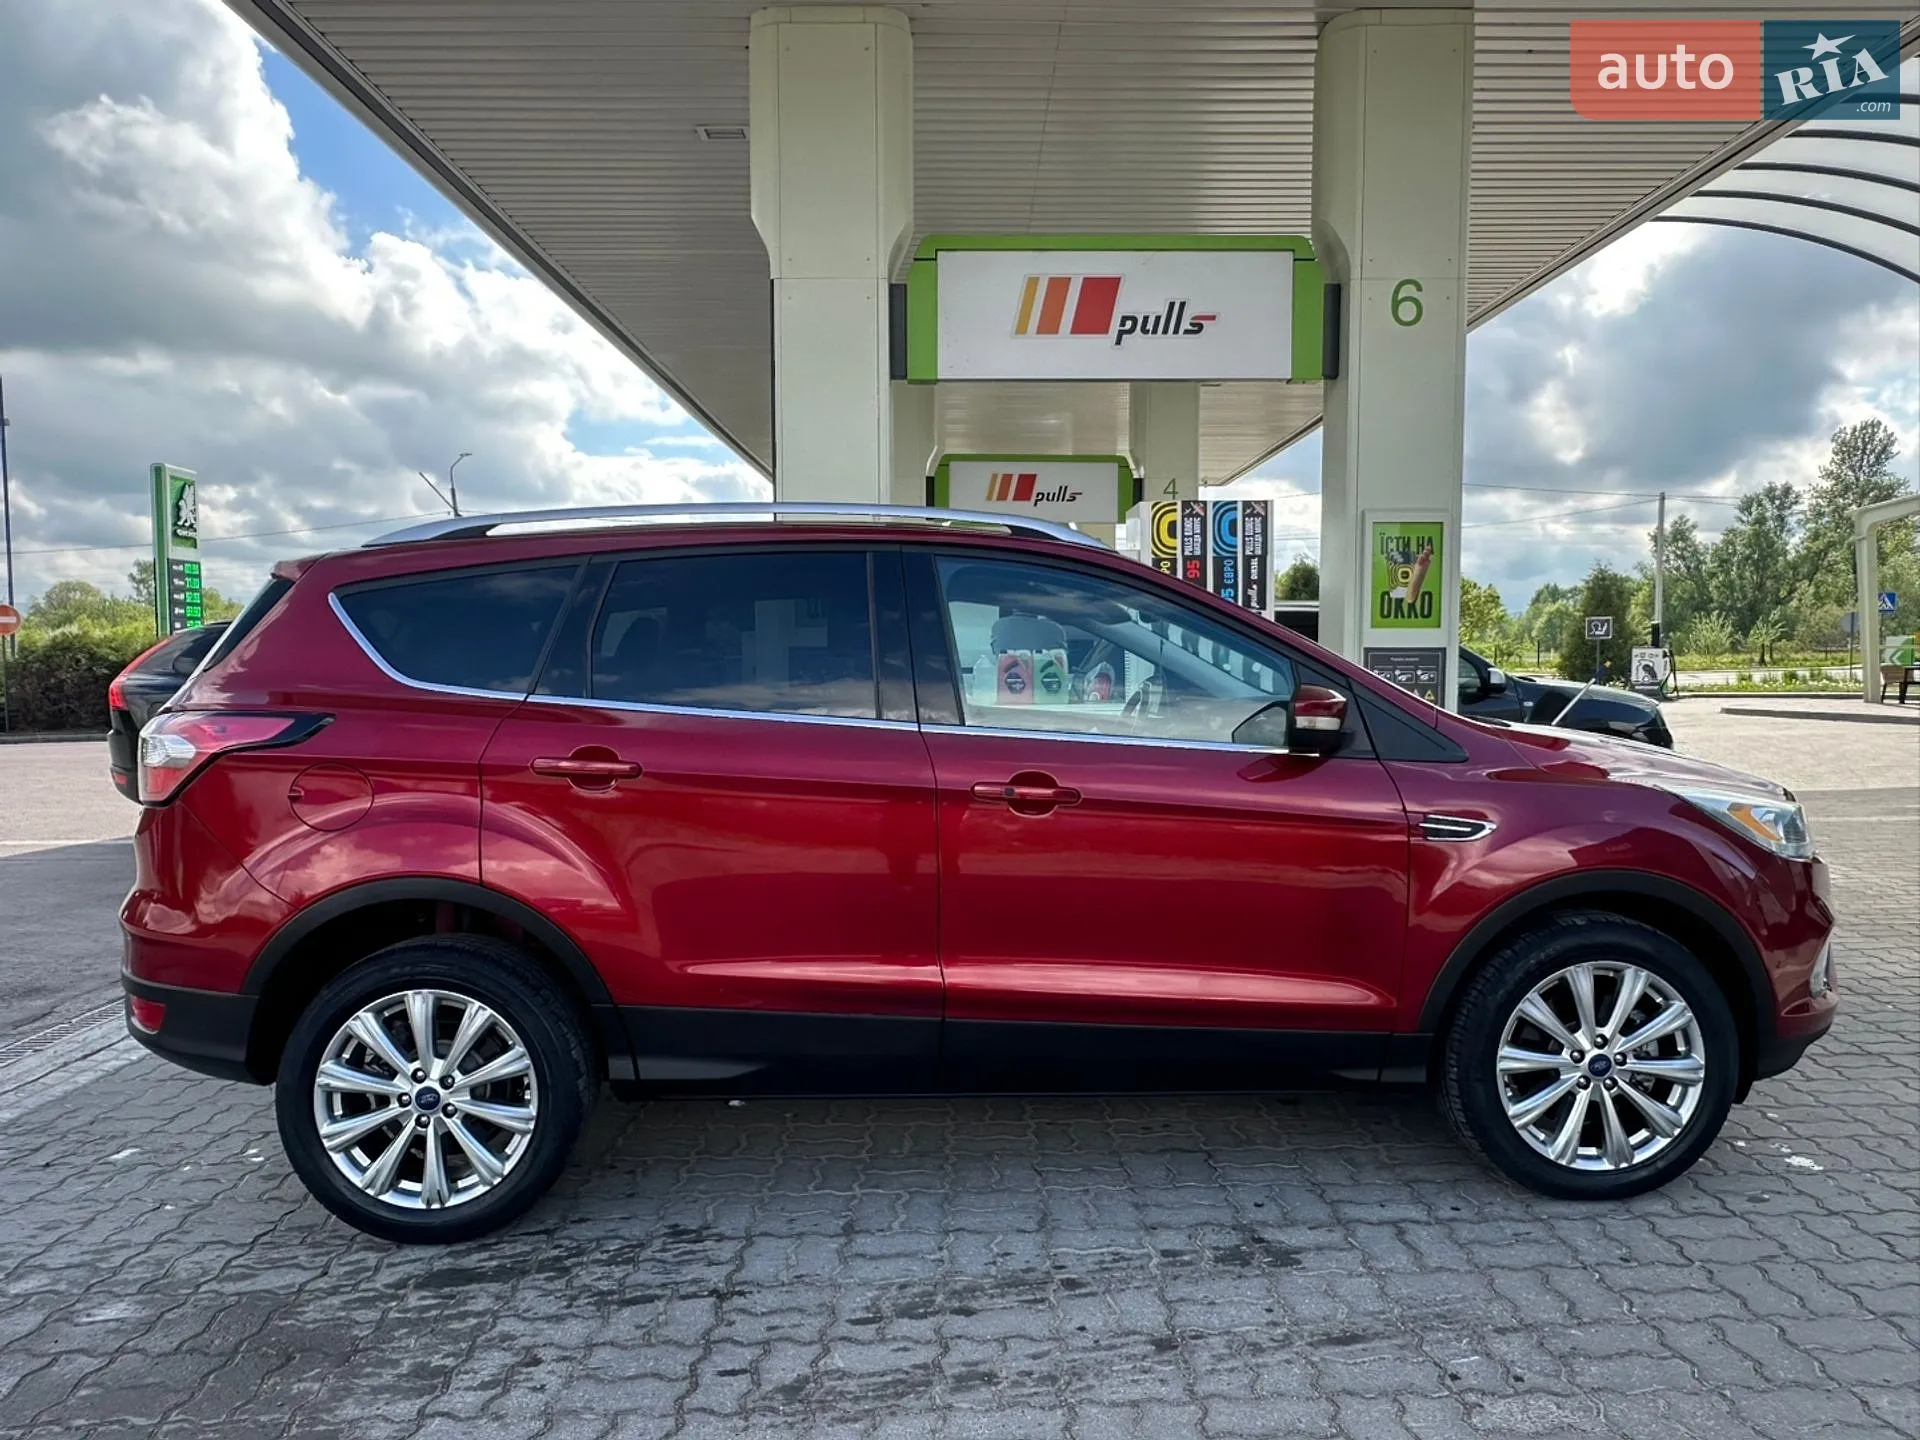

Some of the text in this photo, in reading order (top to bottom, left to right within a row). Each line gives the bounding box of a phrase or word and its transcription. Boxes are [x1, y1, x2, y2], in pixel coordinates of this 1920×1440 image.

[1391, 278, 1423, 327] 6
[1114, 300, 1217, 346] pulls
[1033, 485, 1083, 507] pulls
[1163, 477, 1179, 500] 4
[1379, 531, 1435, 555] ЇСТИ НА
[1186, 560, 1200, 578] 95
